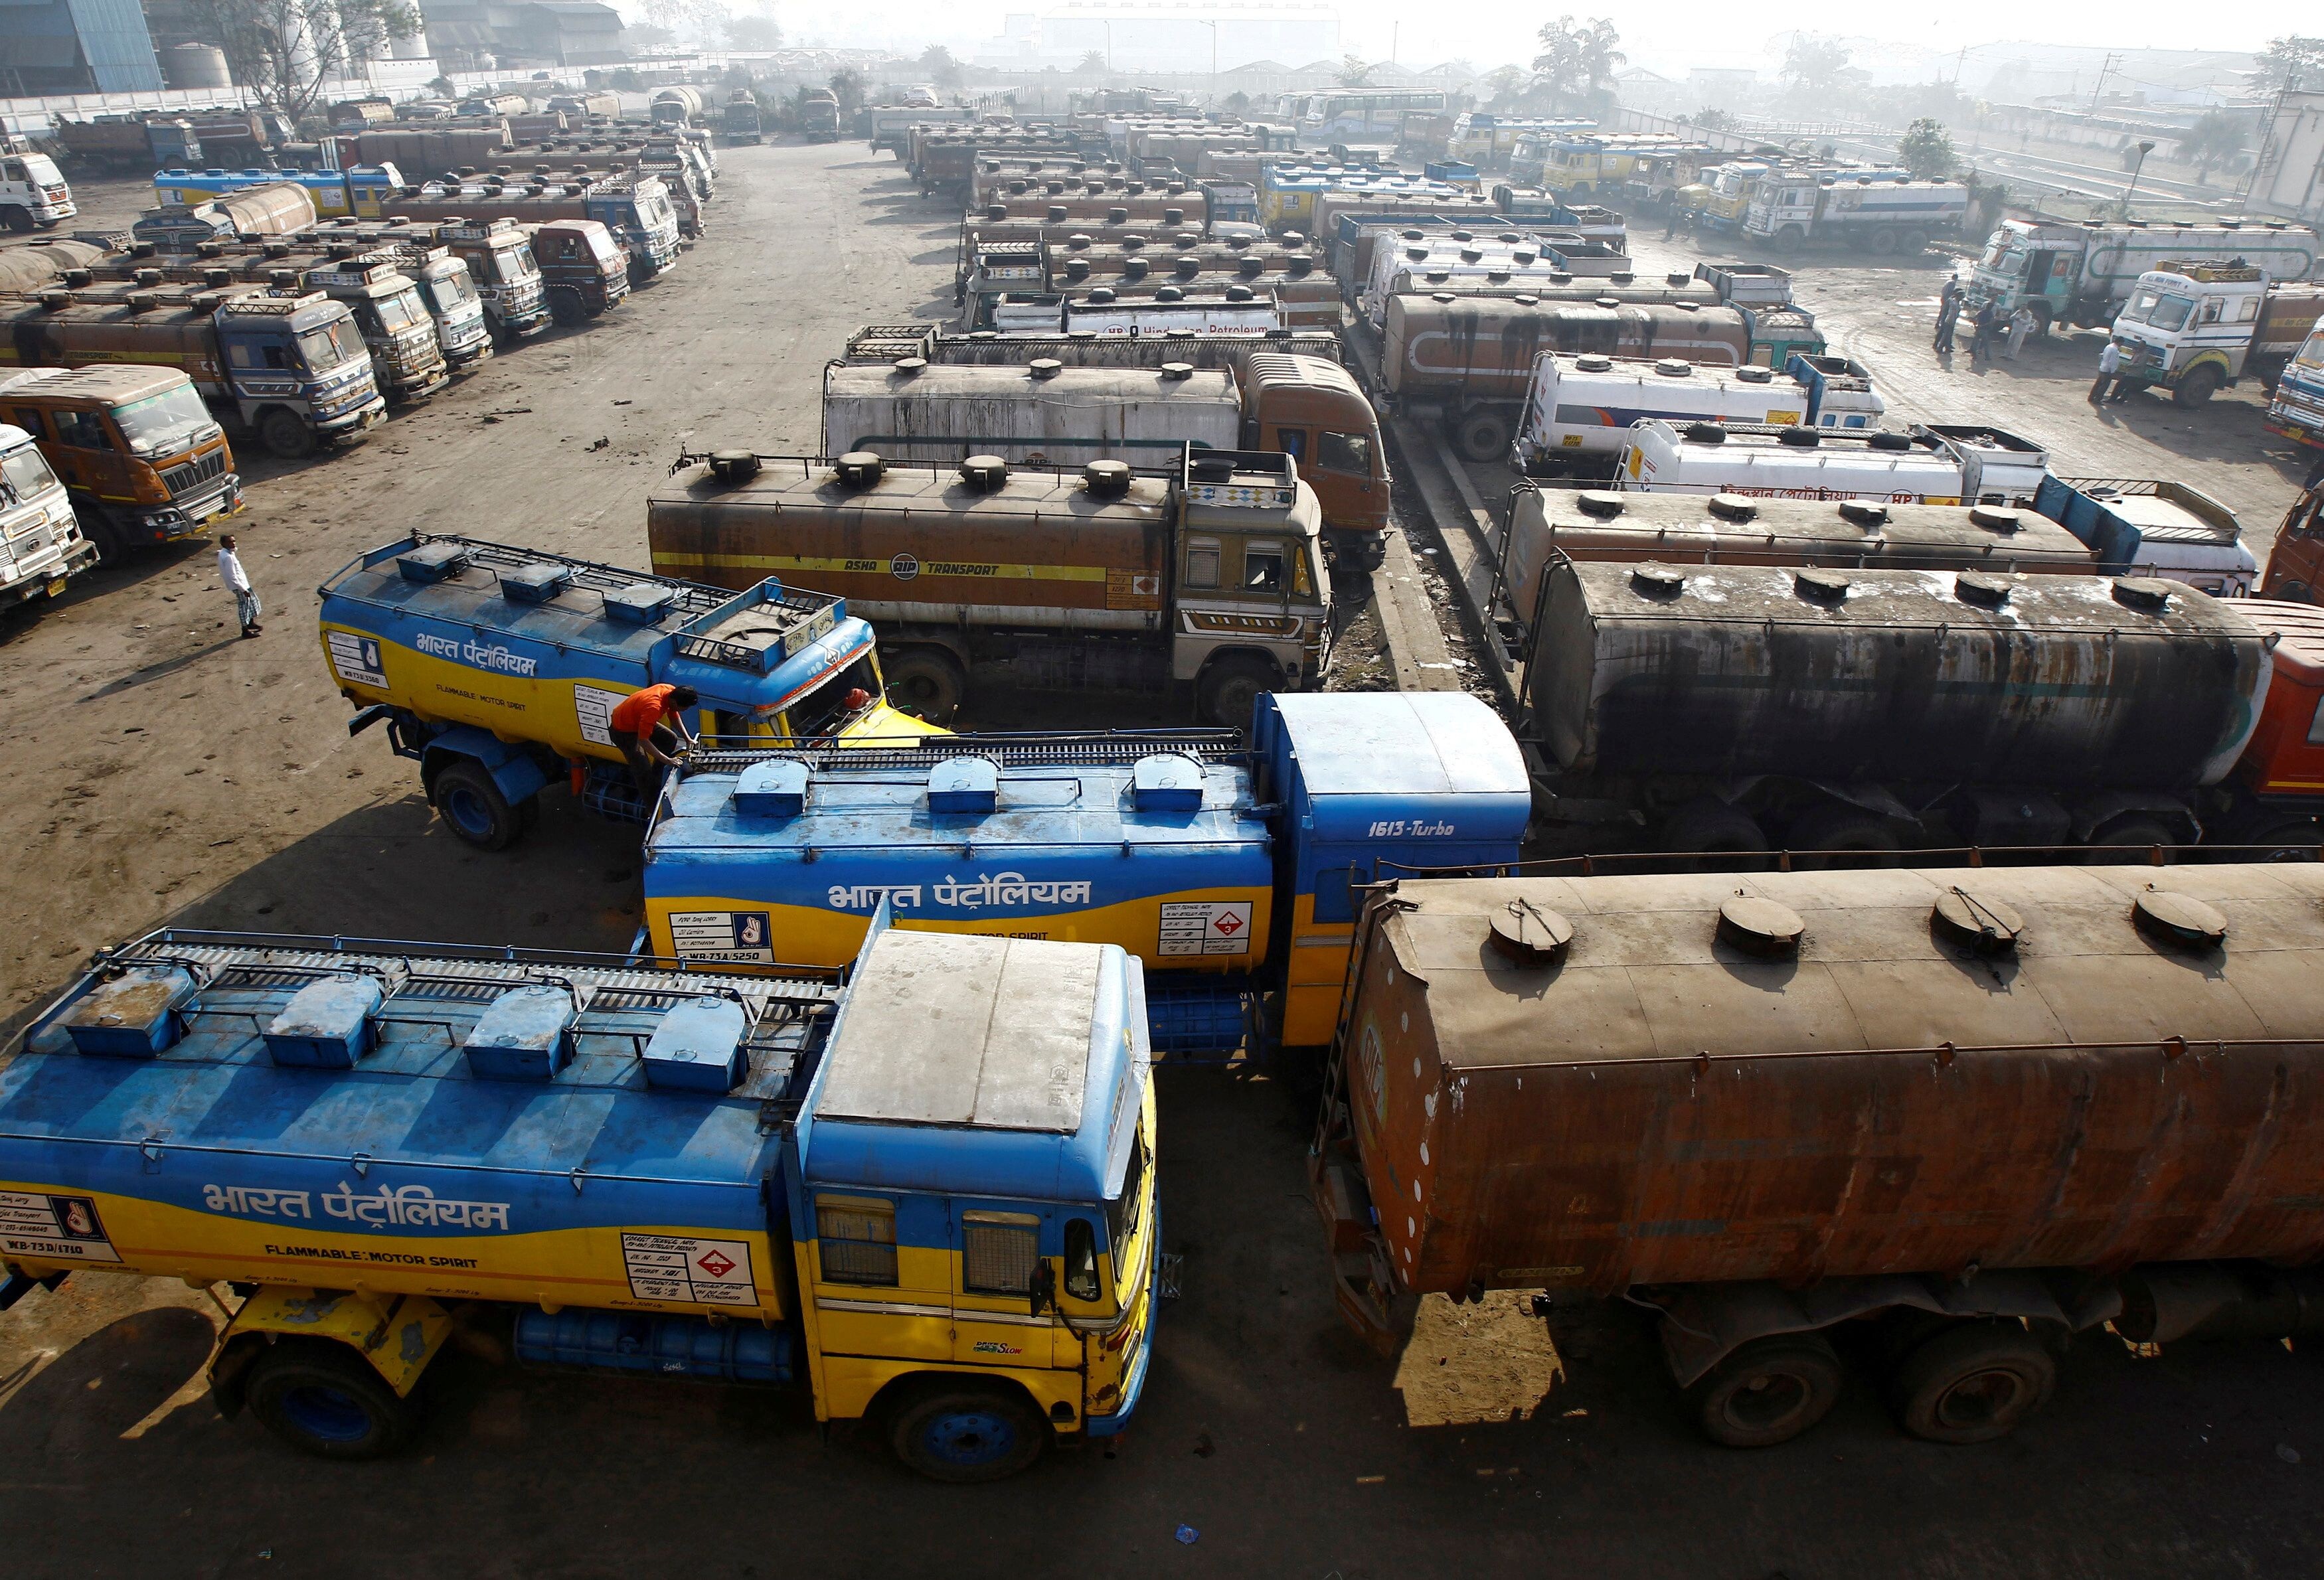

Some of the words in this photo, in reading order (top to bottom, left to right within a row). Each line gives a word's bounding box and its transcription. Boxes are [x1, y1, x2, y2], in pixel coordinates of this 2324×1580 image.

[1210, 324, 1267, 333] Petroleum
[844, 560, 876, 570] ASHA
[928, 563, 999, 576] TRANSPORT
[416, 633, 459, 659] भारत
[463, 639, 537, 676] पेट्रोलियम
[479, 695, 505, 707] MOTOR
[507, 701, 526, 711] SPIRIT
[933, 872, 1091, 911] पेट्रोलियम
[203, 1184, 312, 1219] भारत
[321, 1180, 510, 1231] पेट्रोलियम
[370, 1252, 425, 1265] MOTOR
[430, 1256, 477, 1269] SPIRIT
[997, 1343, 1023, 1354] SLOW
